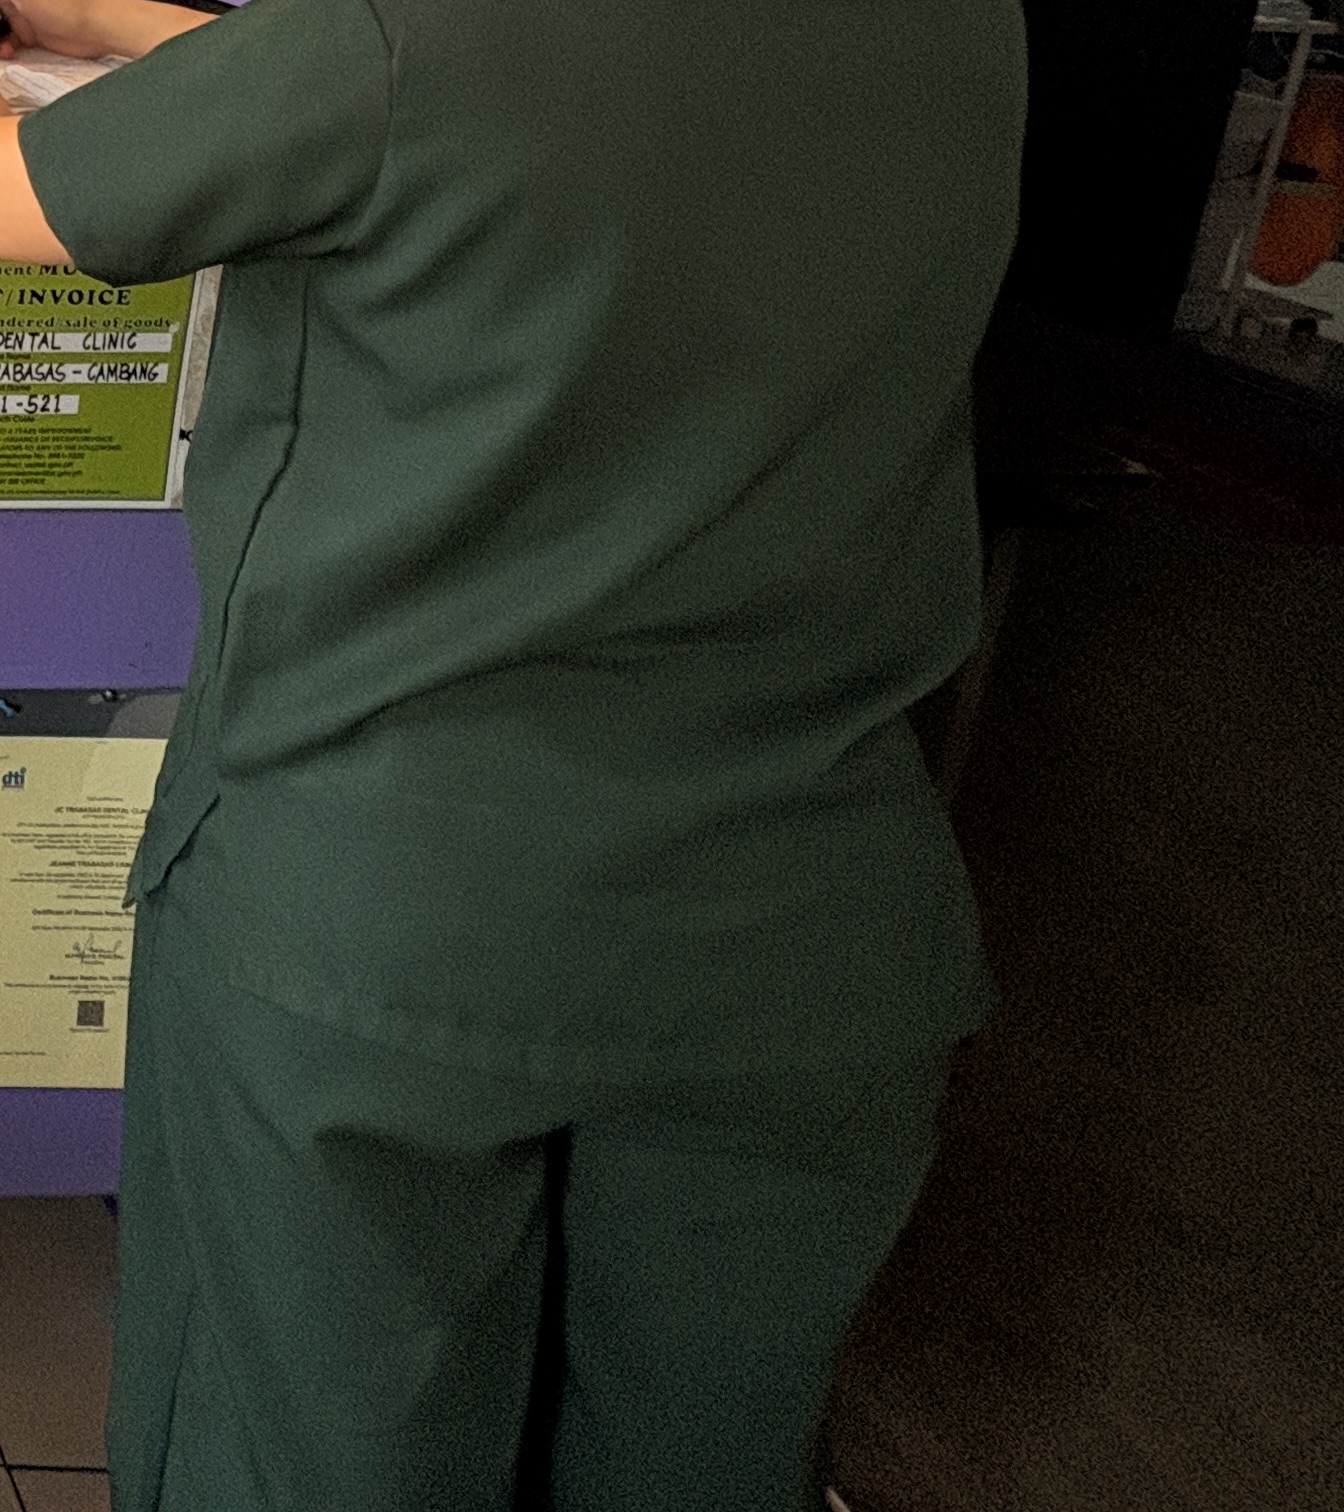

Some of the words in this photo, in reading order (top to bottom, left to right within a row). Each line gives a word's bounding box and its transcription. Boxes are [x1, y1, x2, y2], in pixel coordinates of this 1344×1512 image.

[65, 317, 97, 328] sale
[102, 317, 120, 328] of
[124, 317, 171, 330] goods
[82, 332, 138, 351] CLINIC
